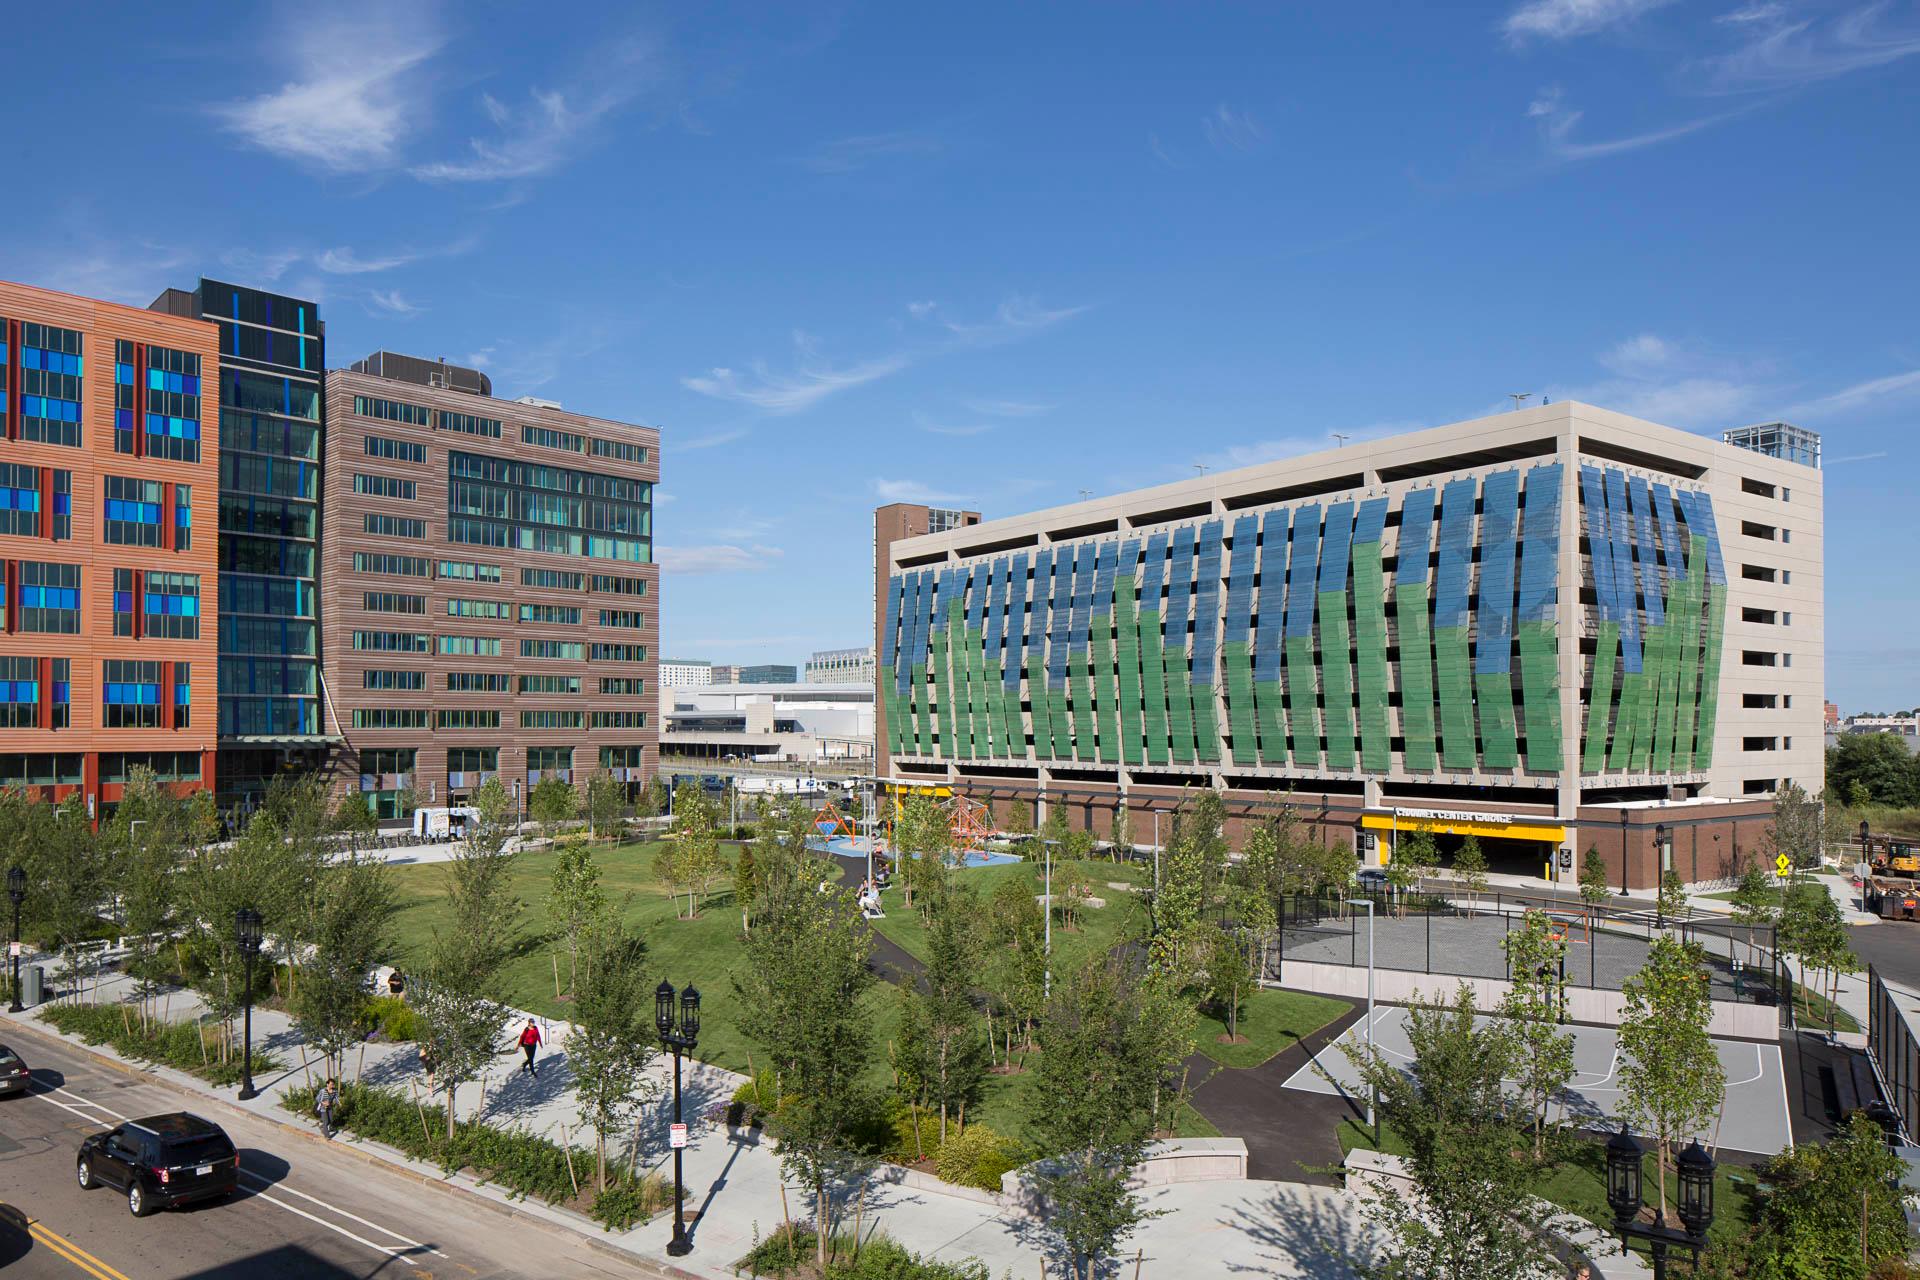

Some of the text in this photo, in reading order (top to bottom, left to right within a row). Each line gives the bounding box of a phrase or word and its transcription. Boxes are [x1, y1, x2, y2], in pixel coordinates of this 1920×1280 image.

[1396, 808, 1513, 824] CHANNEL CENTER GARAGE
